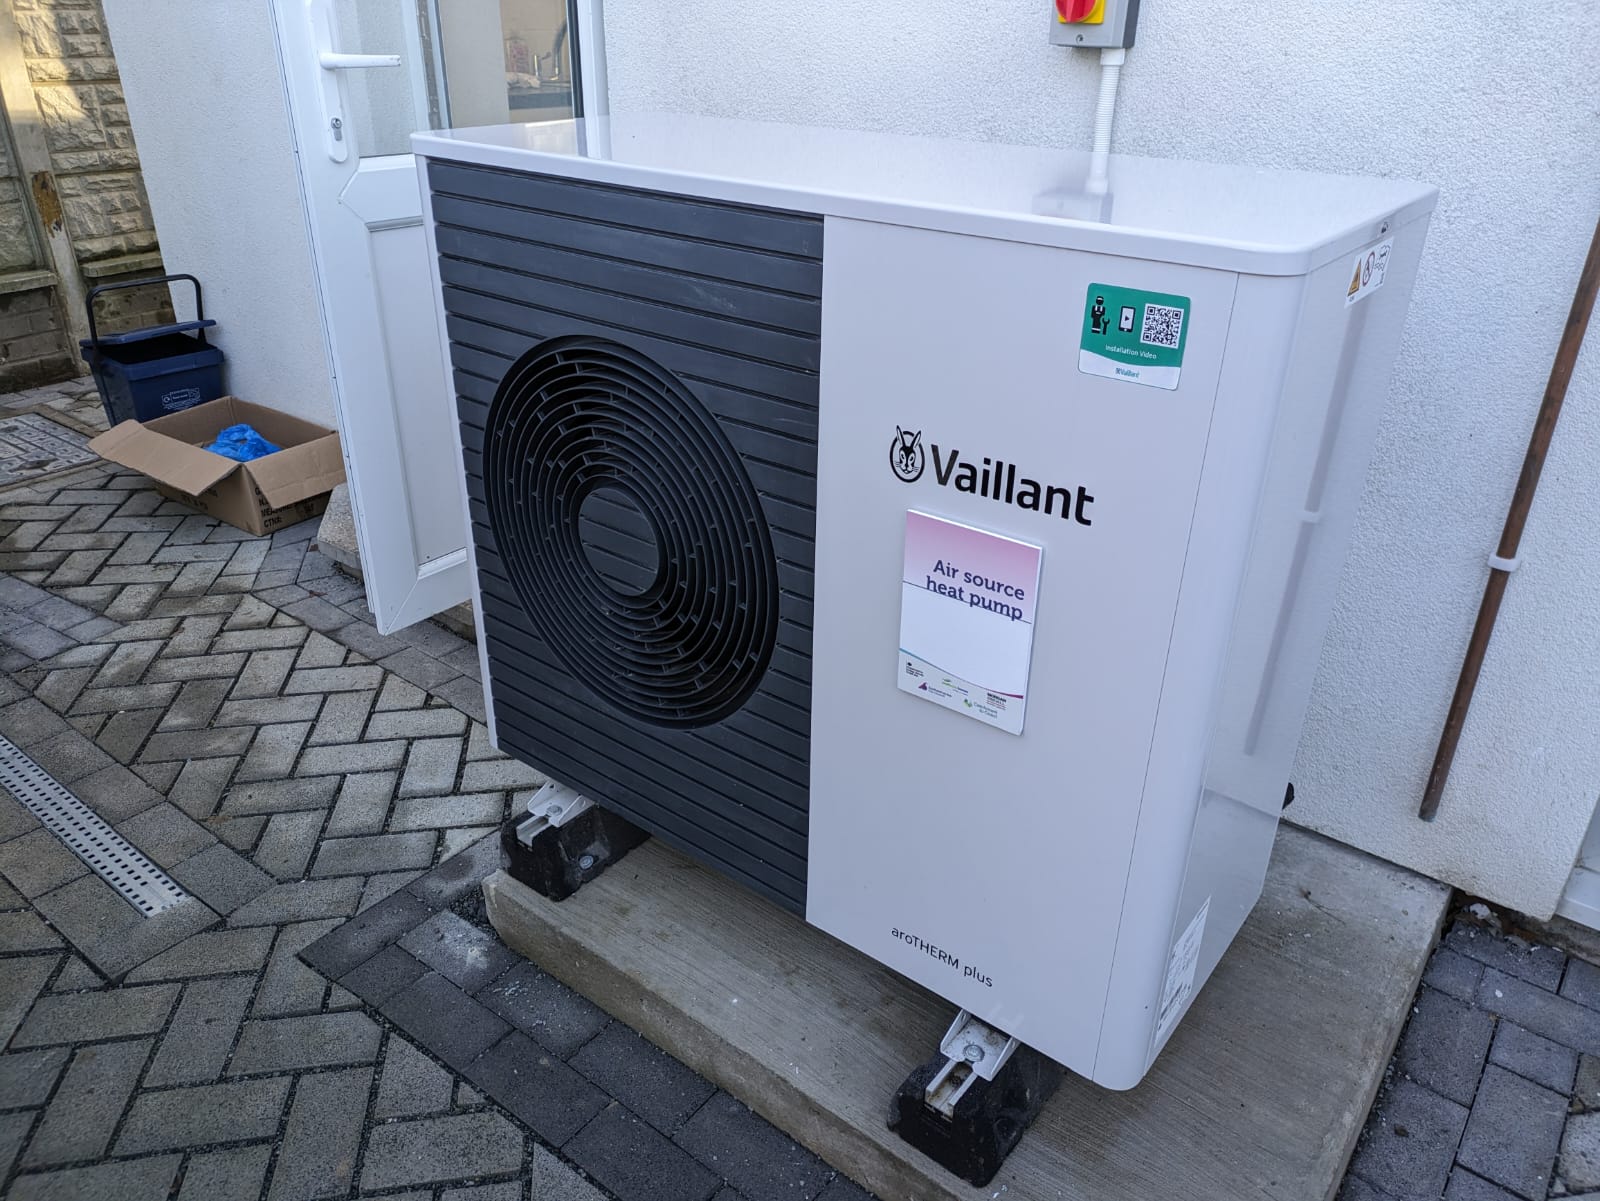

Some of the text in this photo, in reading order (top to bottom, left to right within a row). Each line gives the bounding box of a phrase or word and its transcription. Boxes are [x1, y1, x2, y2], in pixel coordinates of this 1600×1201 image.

[1105, 344, 1157, 359] Installation Video
[931, 444, 1095, 526] Vaillant
[926, 575, 1023, 622] heat pump
[933, 559, 1025, 601] Air source
[891, 927, 993, 988] aroTHERM plus
